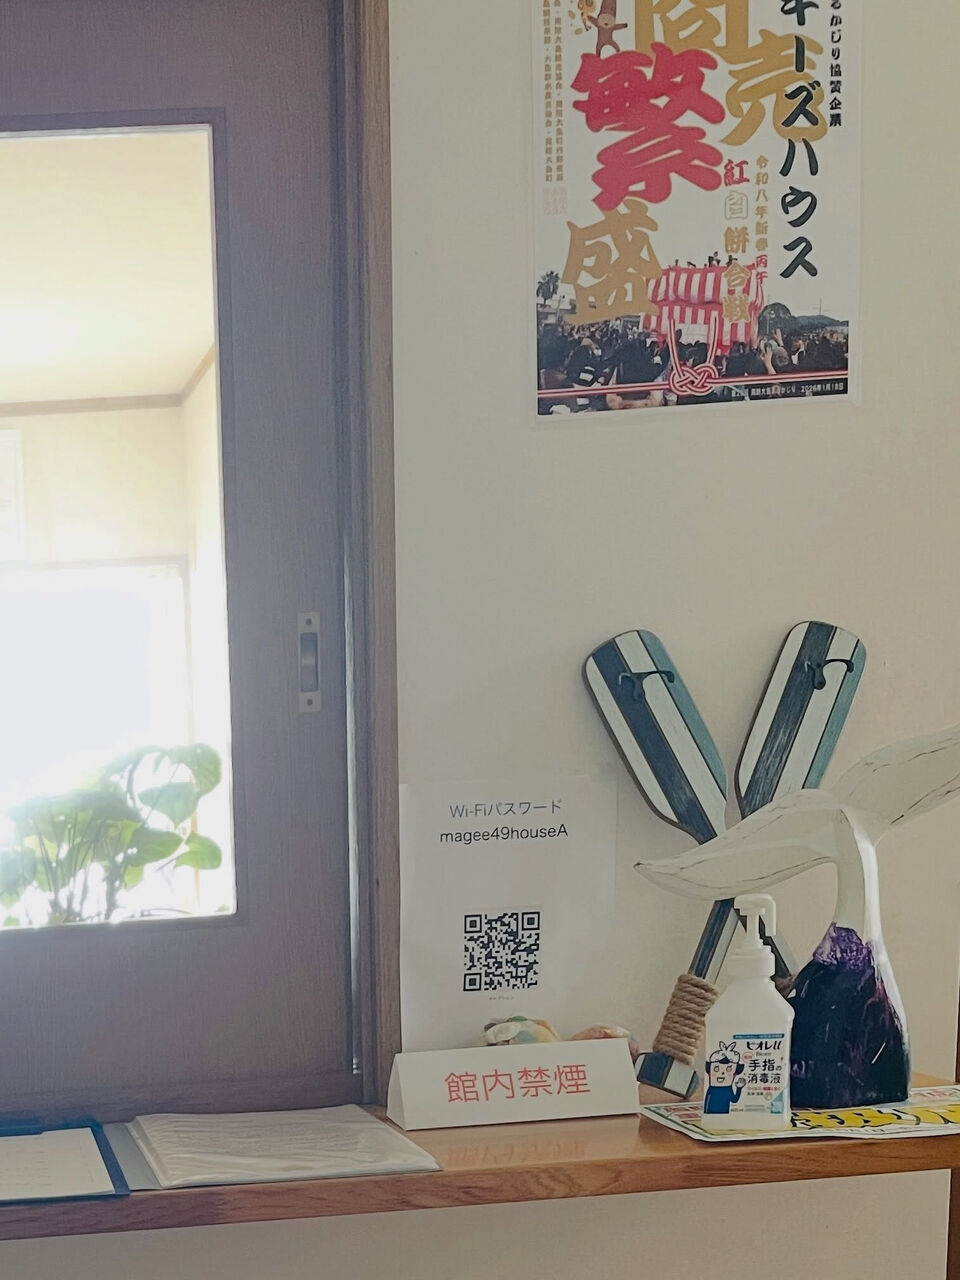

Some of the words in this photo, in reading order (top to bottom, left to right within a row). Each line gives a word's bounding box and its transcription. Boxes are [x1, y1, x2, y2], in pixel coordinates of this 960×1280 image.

[450, 799, 563, 819] Wi-Fiパスワード
[440, 823, 568, 845] magee49houseA
[748, 1058, 782, 1072] 手指の
[444, 1063, 591, 1103] 館内禁煙
[747, 1072, 782, 1084] 消毒液
